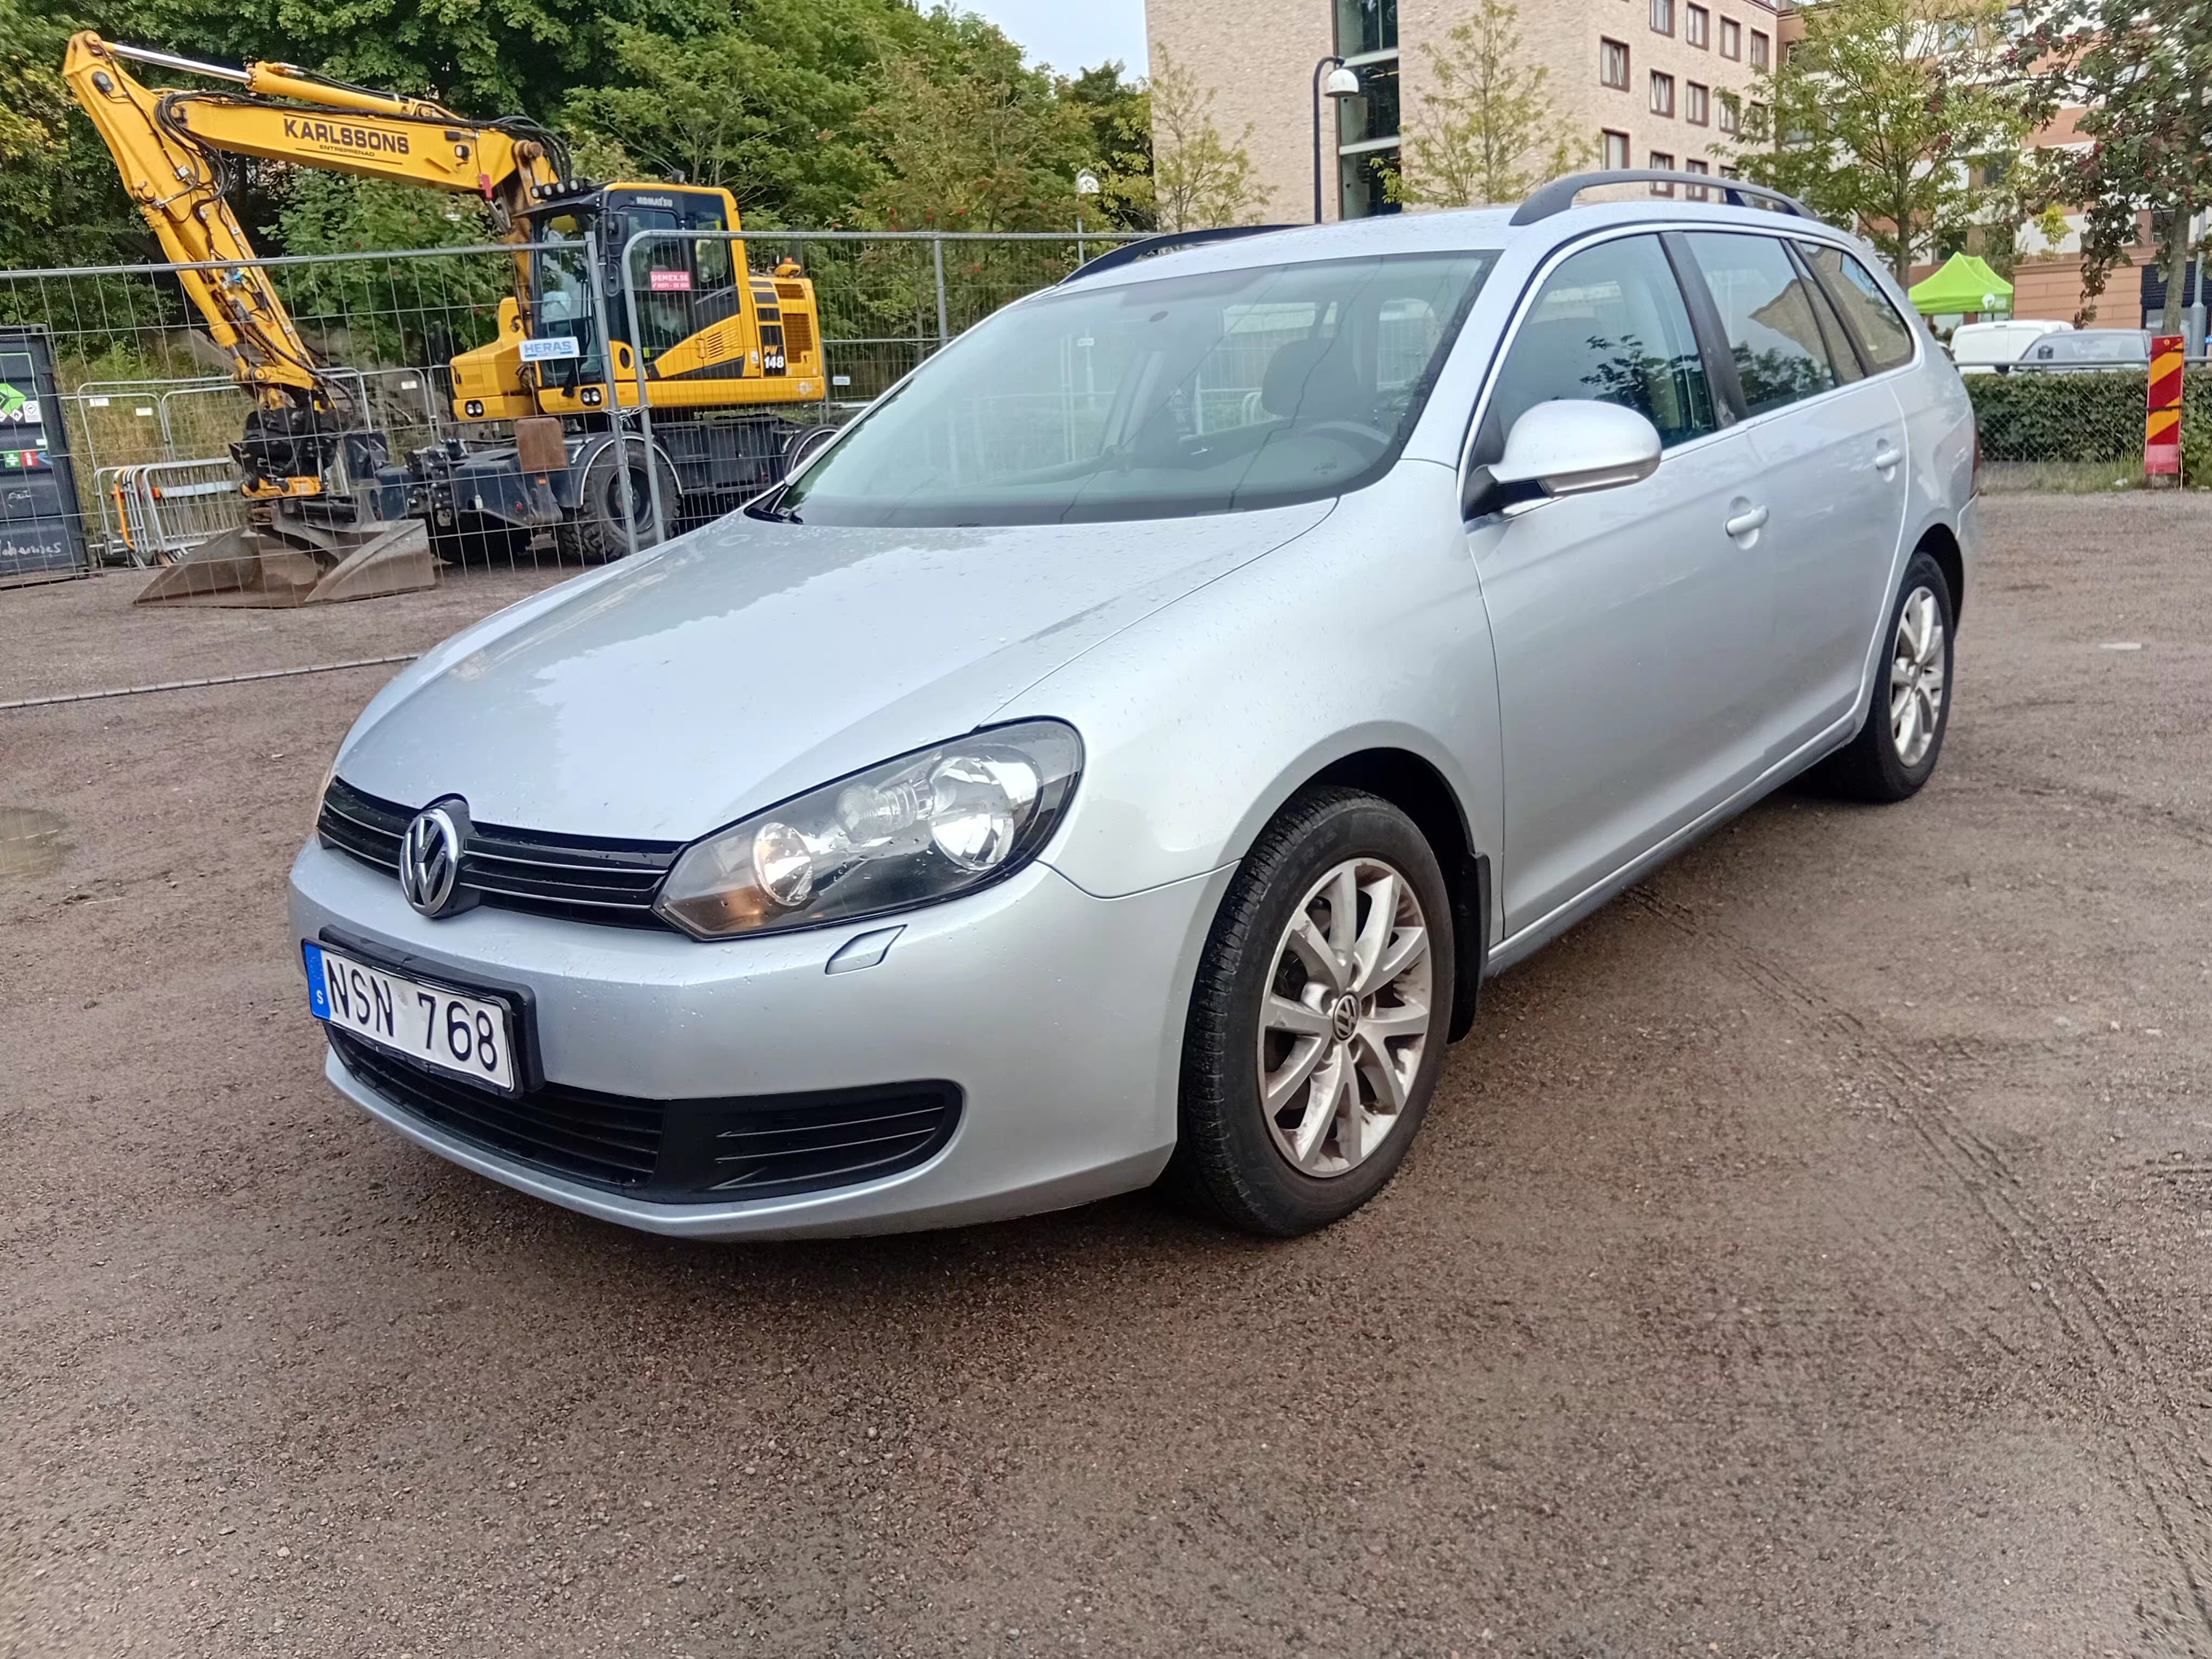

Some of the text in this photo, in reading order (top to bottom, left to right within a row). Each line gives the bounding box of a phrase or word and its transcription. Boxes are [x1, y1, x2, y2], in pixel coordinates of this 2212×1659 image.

[284, 118, 409, 155] KARLSSONS
[319, 144, 375, 157] ENTREPRENAD
[636, 196, 673, 208] KOMATSU
[524, 341, 571, 353] HERAS
[764, 346, 779, 356] PW
[764, 356, 785, 369] 148
[317, 958, 498, 1072] S NSN 768
